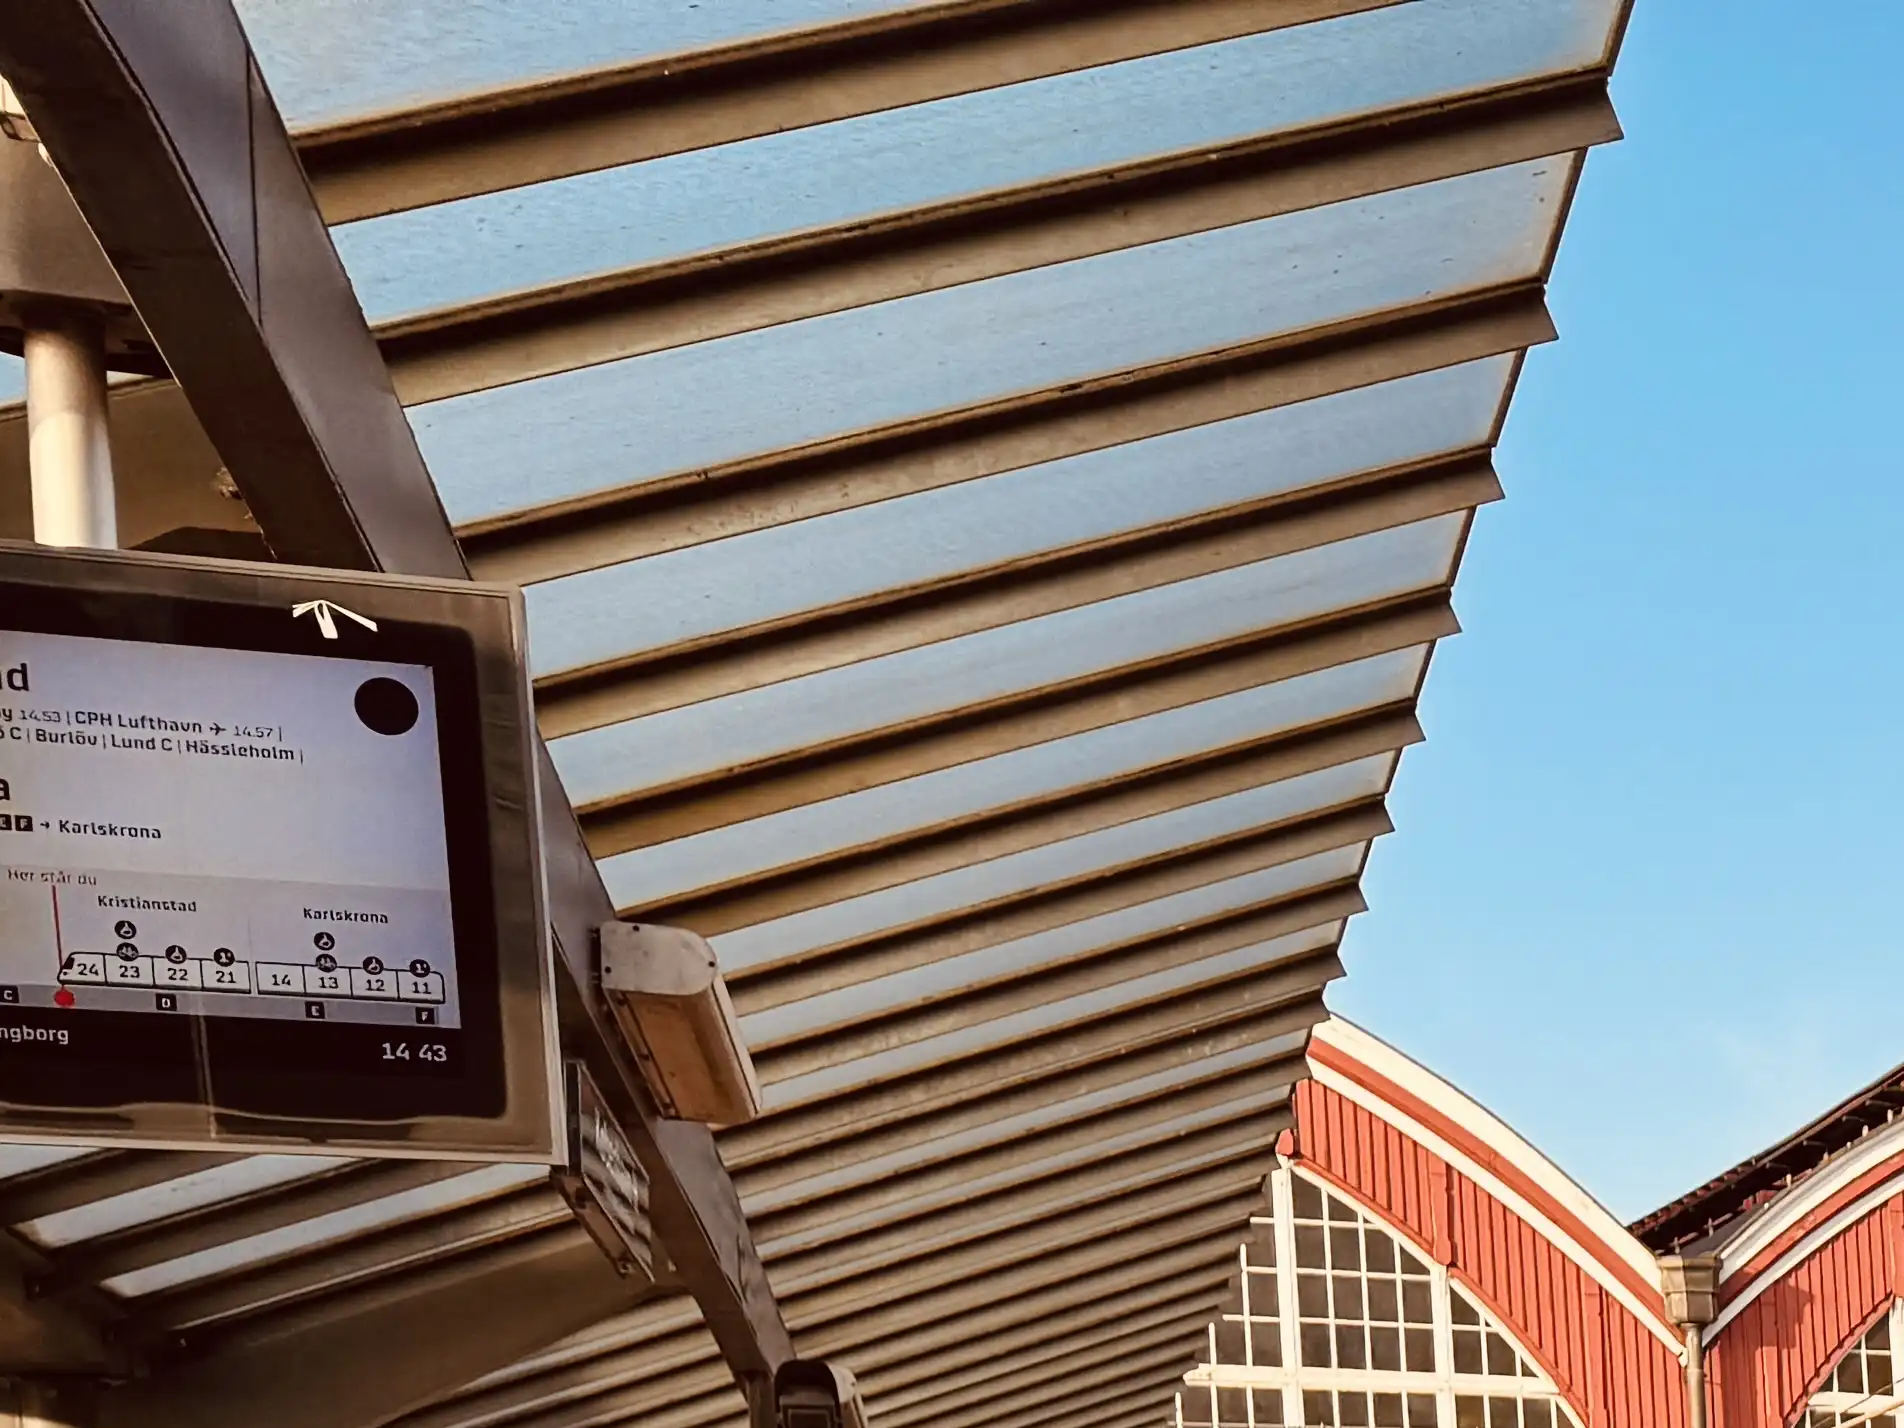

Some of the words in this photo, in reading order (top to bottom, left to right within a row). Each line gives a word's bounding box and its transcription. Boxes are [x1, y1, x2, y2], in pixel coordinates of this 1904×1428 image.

[74, 710, 112, 727] CPH
[117, 714, 202, 734] Lufthavn
[111, 736, 156, 750] Lund
[59, 819, 161, 840] Karlskrona
[303, 907, 389, 924] Karlskrona
[77, 963, 99, 977] 24
[119, 965, 140, 979] 23
[167, 967, 189, 981] 22
[215, 970, 236, 984] 21
[271, 973, 292, 986] 14
[318, 976, 339, 989] 13
[365, 979, 385, 992] 12
[412, 981, 432, 995] 11
